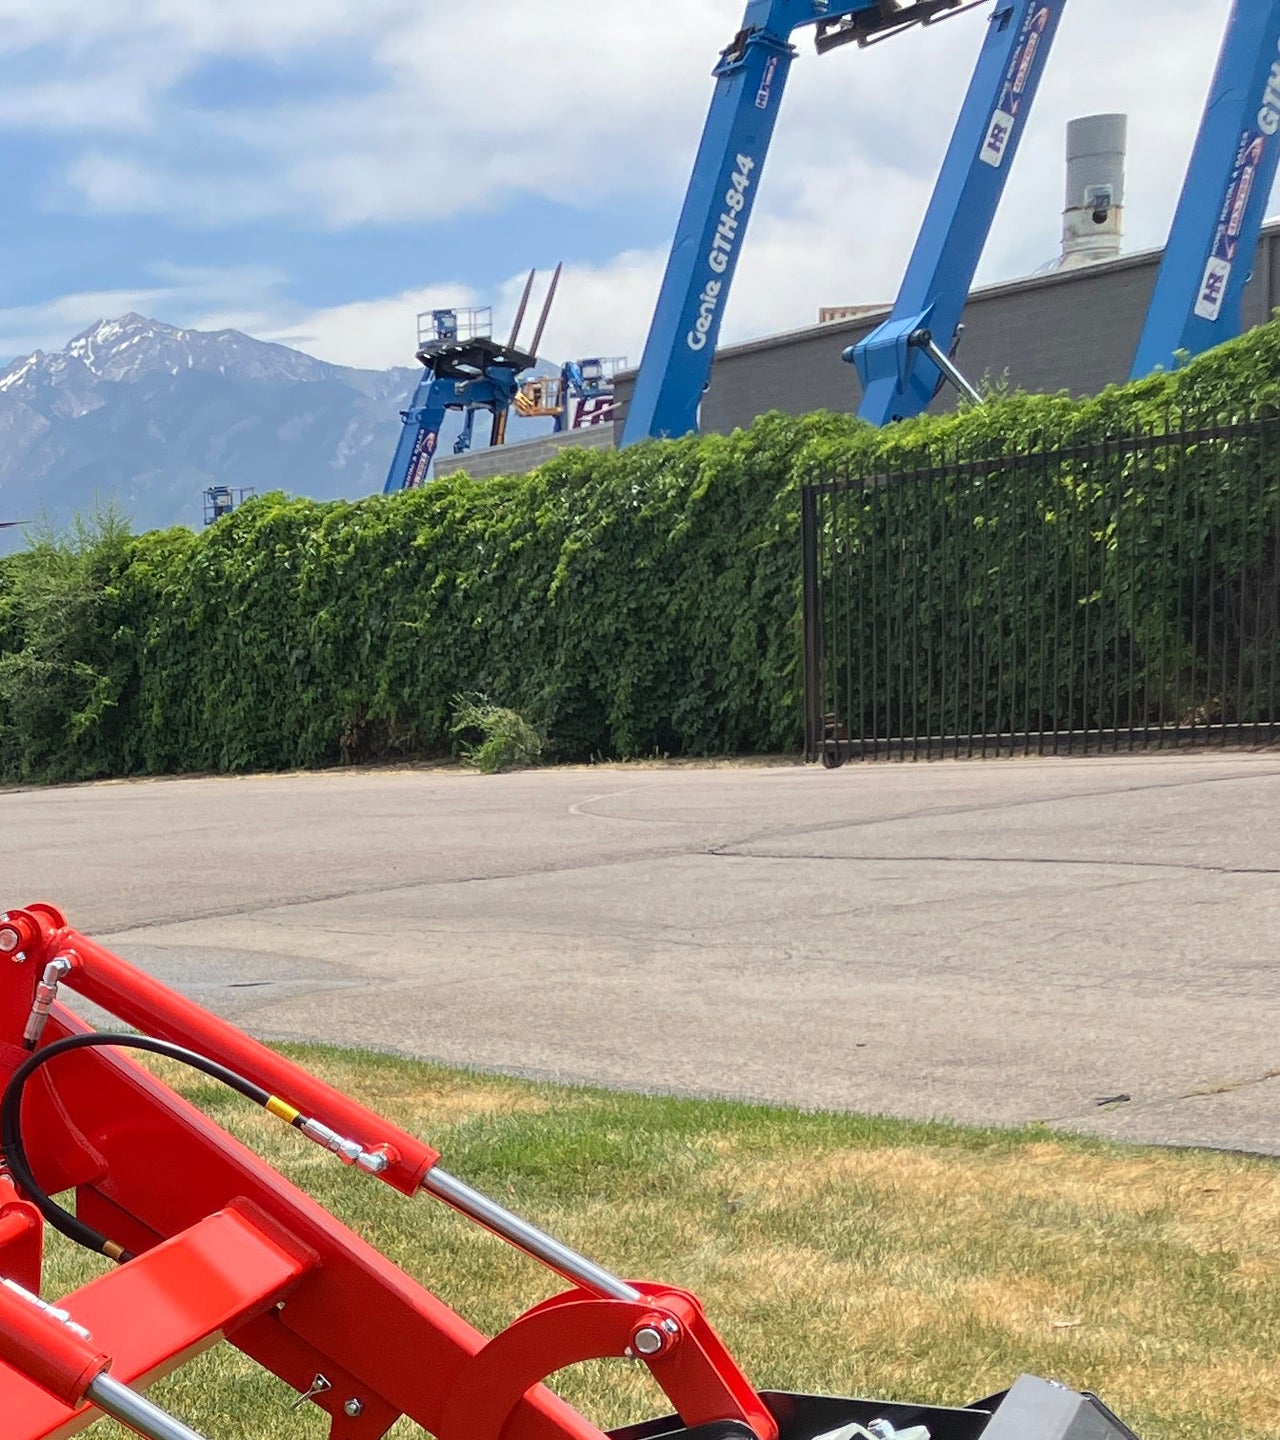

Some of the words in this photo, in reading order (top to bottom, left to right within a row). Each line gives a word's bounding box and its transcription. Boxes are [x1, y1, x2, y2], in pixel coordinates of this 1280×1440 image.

[987, 122, 1008, 154] HR
[686, 279, 722, 351] Genie
[708, 153, 756, 274] GTH-844
[1202, 271, 1225, 305] HR
